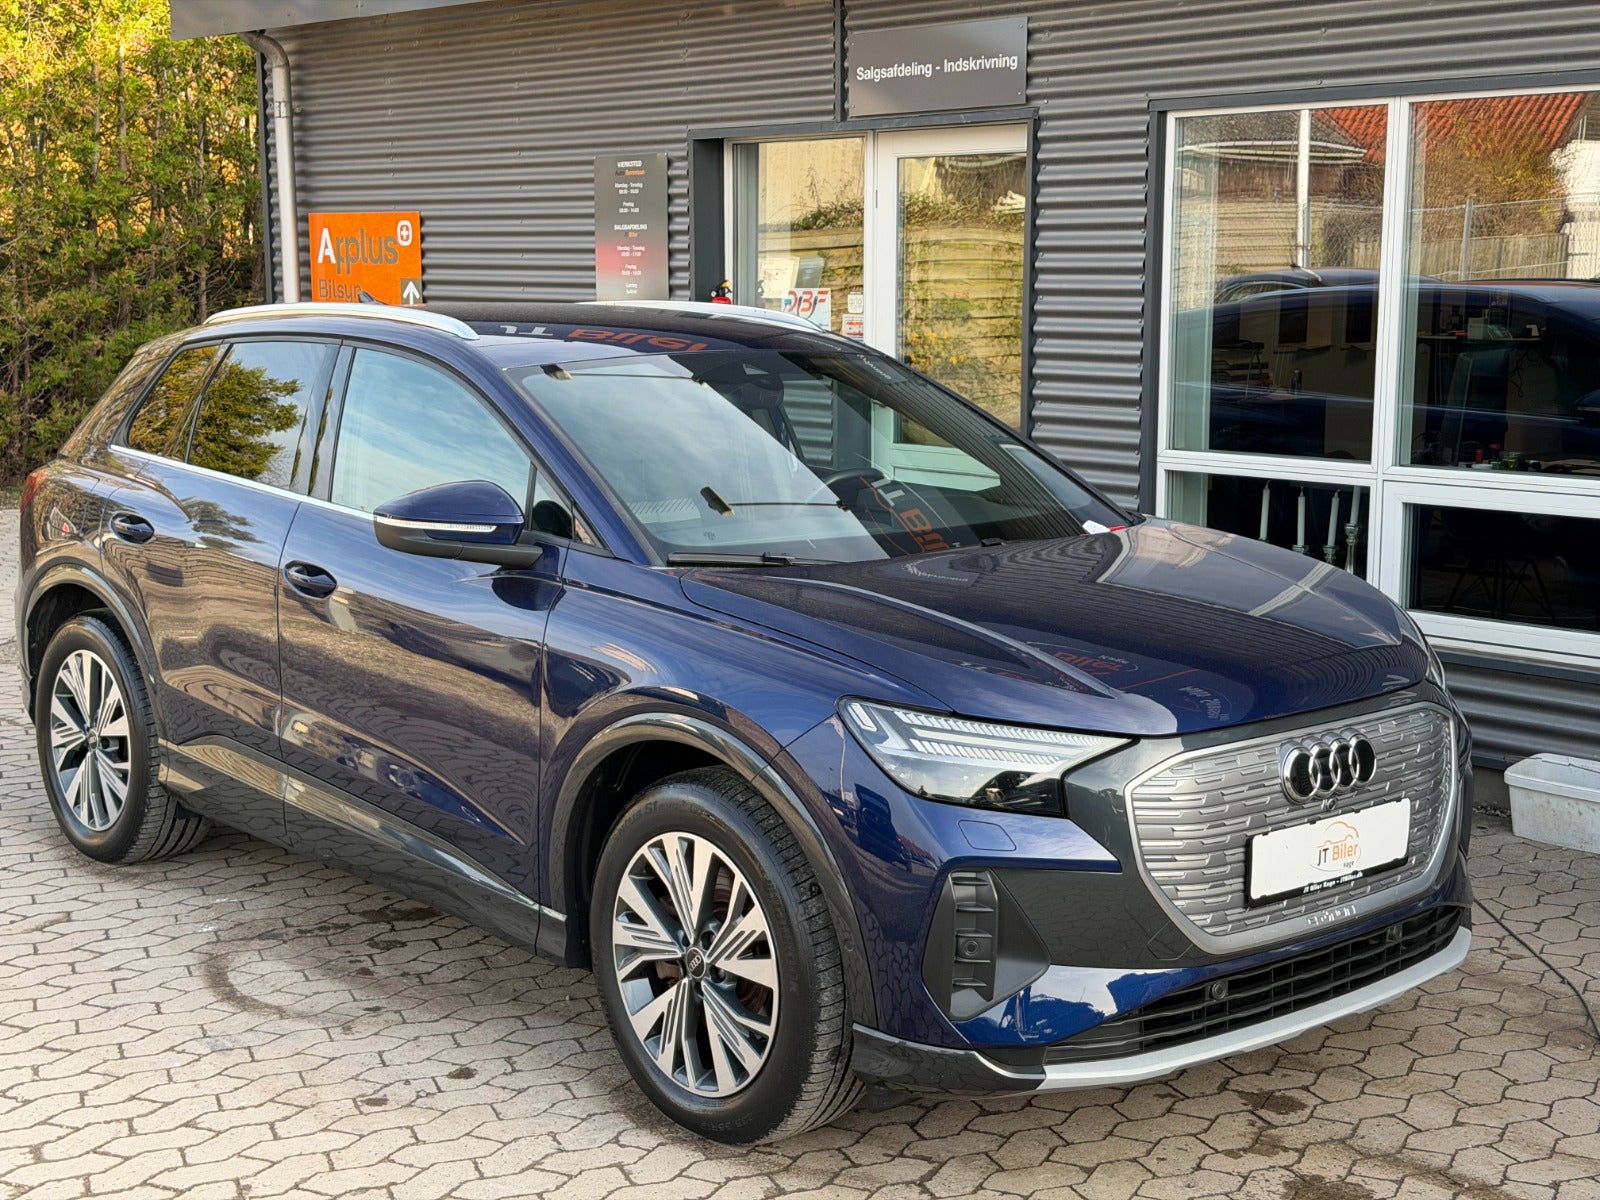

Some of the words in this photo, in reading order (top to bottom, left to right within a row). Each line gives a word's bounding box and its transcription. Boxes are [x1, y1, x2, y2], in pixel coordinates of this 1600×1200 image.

[856, 62, 933, 82] Salgsafdeling
[943, 54, 1018, 73] Indskrivning
[1317, 848, 1330, 867] JT
[1331, 842, 1359, 862] Biler
